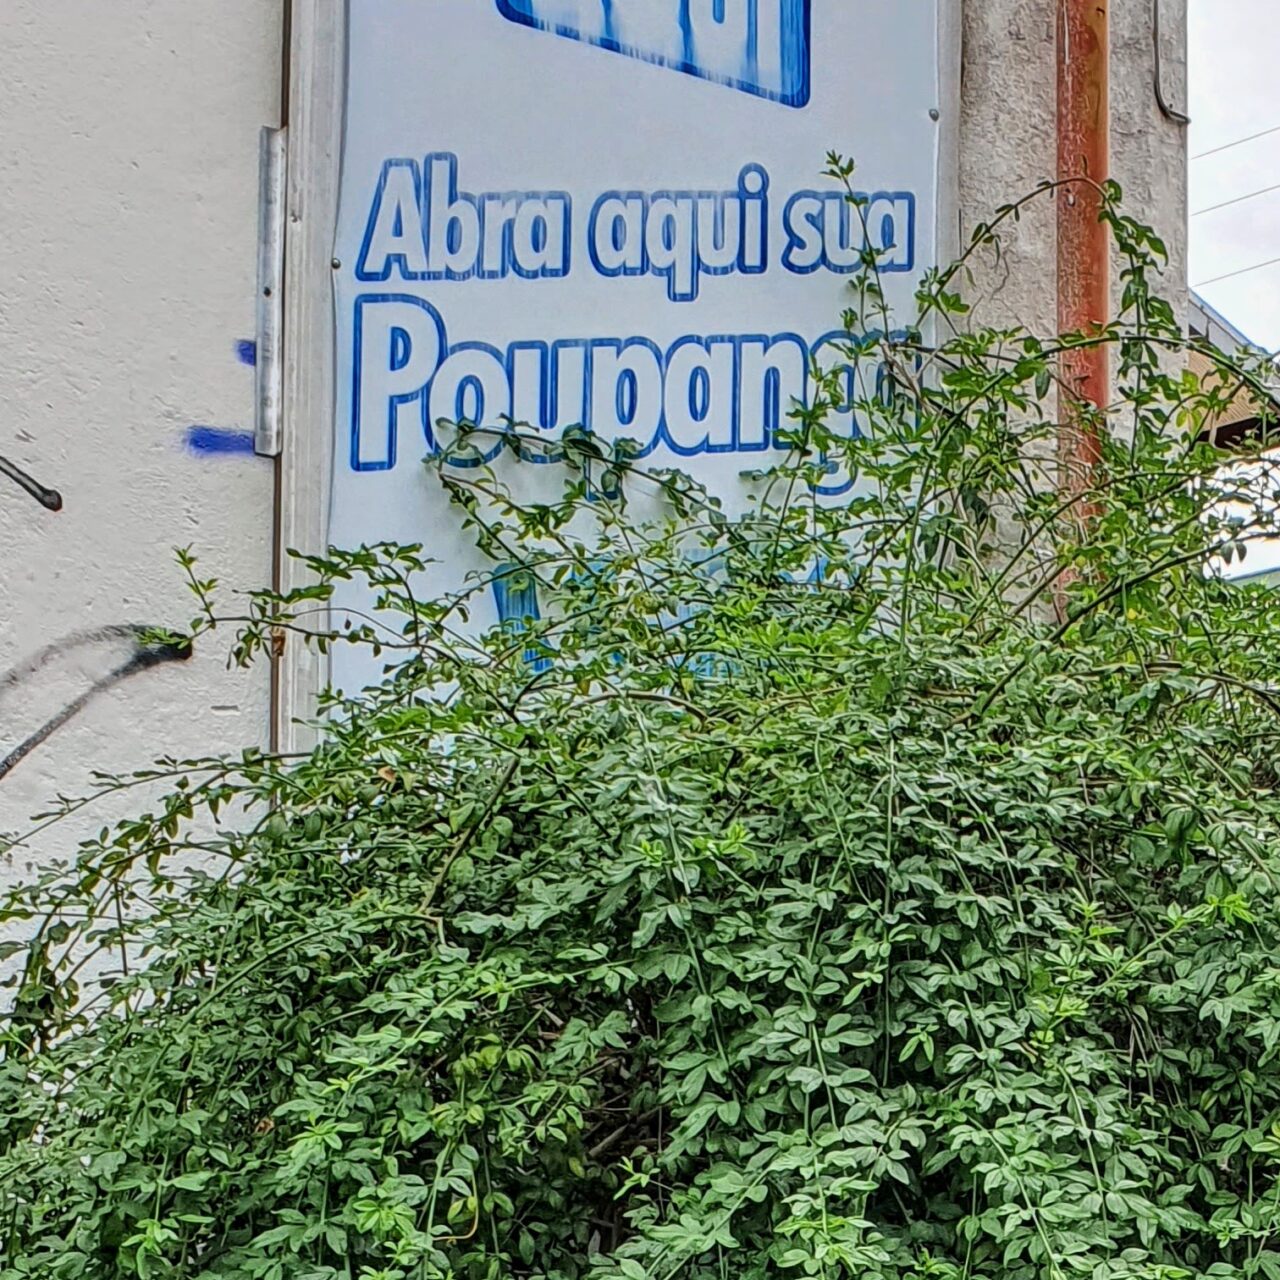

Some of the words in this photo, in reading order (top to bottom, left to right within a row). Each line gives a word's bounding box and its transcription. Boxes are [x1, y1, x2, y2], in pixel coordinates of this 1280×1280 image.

[354, 151, 572, 281] Abra
[588, 162, 769, 302] aqui
[782, 190, 916, 275] sua
